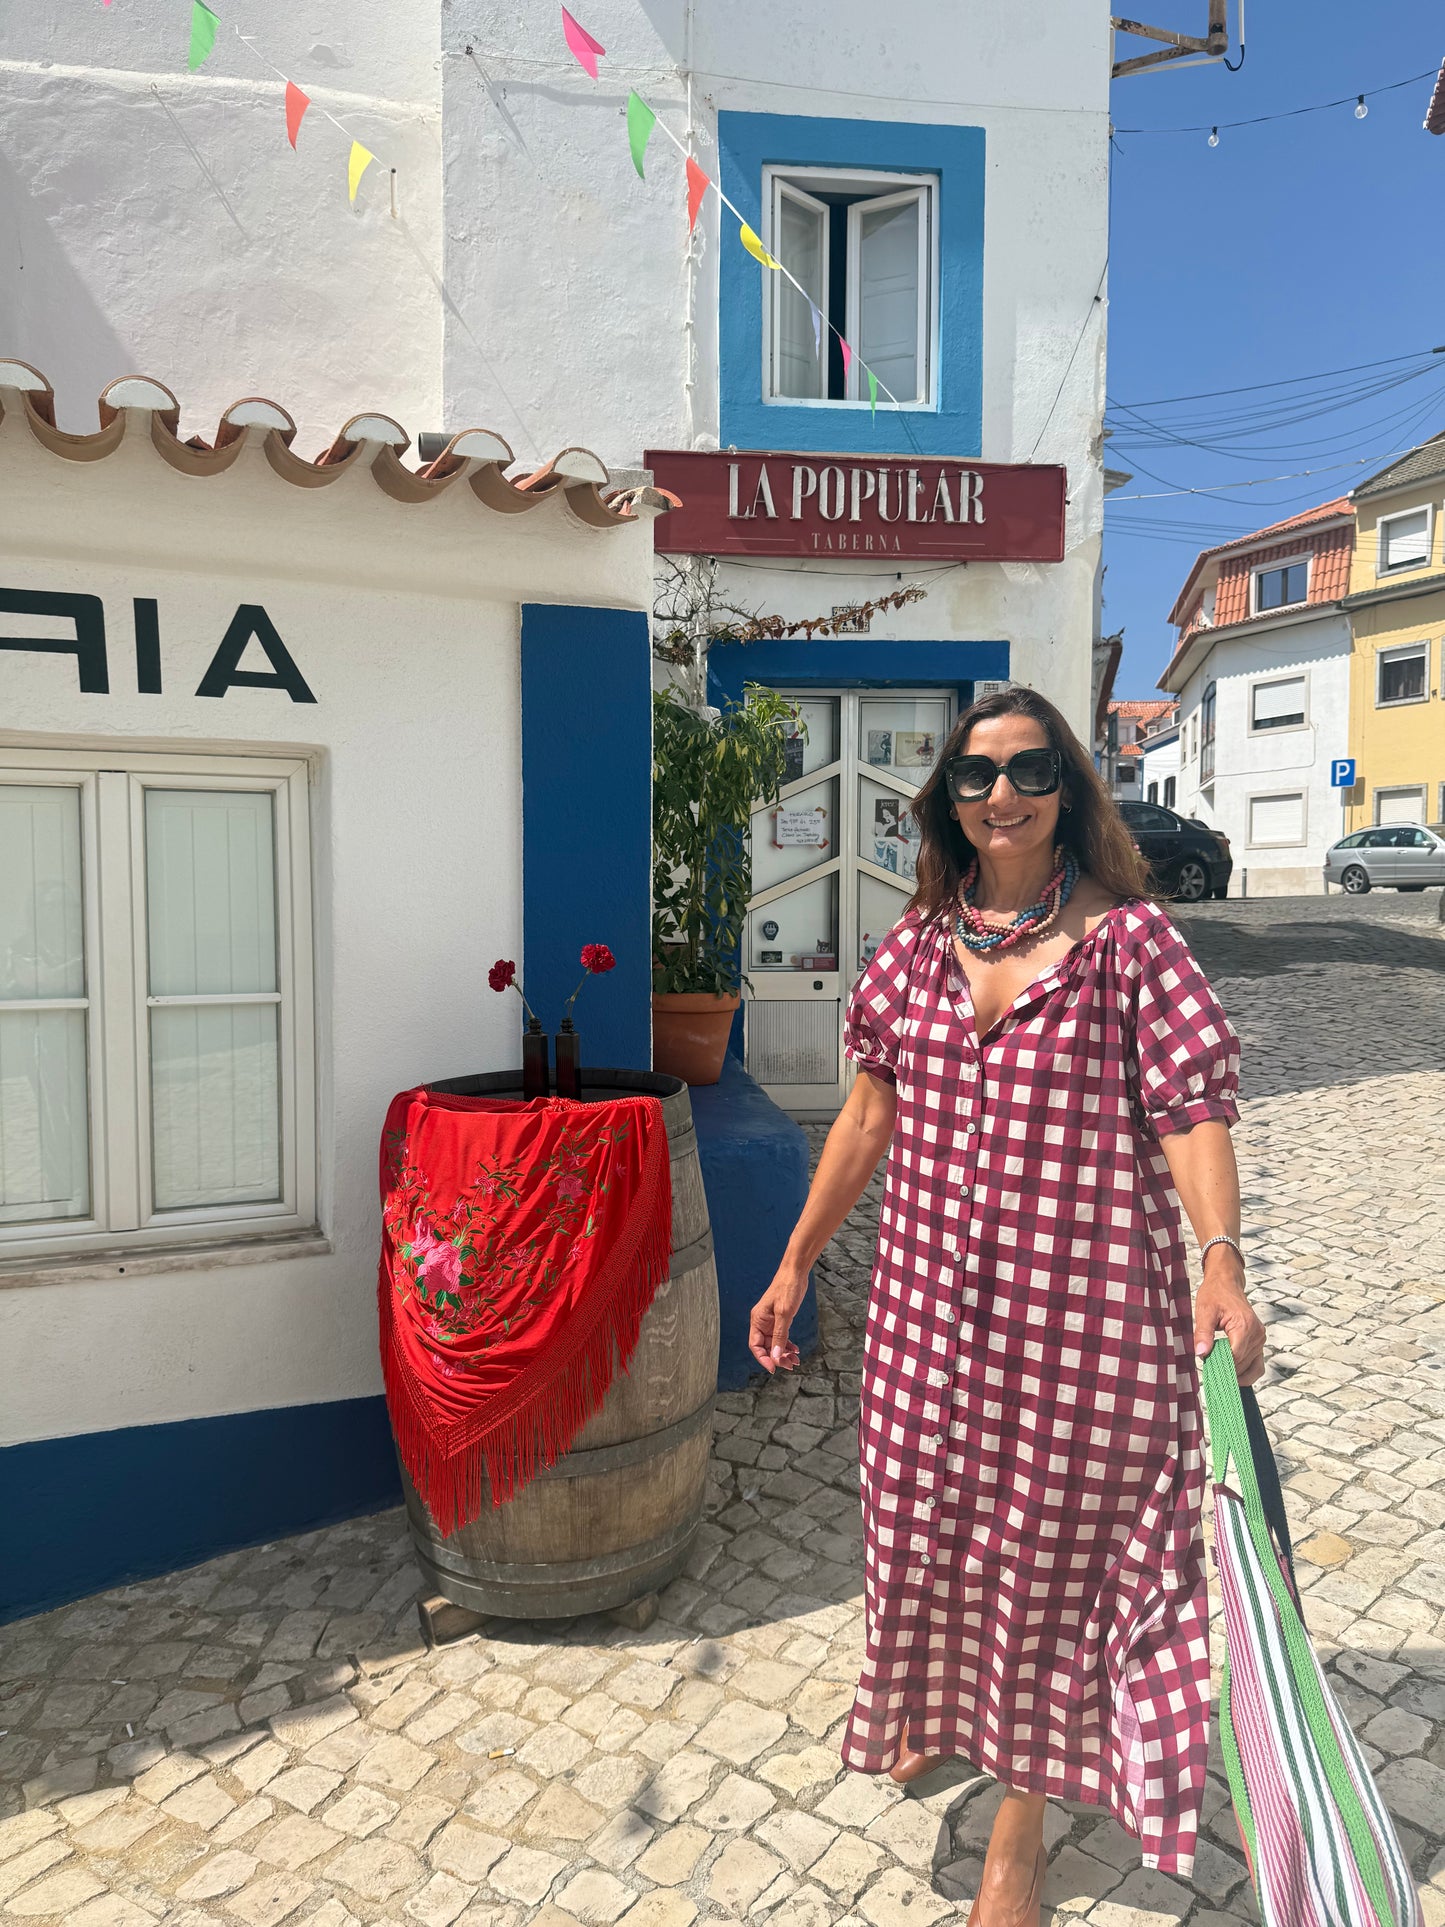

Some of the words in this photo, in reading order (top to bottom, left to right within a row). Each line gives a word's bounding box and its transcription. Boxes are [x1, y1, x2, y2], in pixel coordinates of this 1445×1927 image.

[726, 463, 779, 520] LA
[790, 465, 986, 524] POPULAR
[811, 532, 902, 552] TABERNA
[1335, 762, 1351, 785] P
